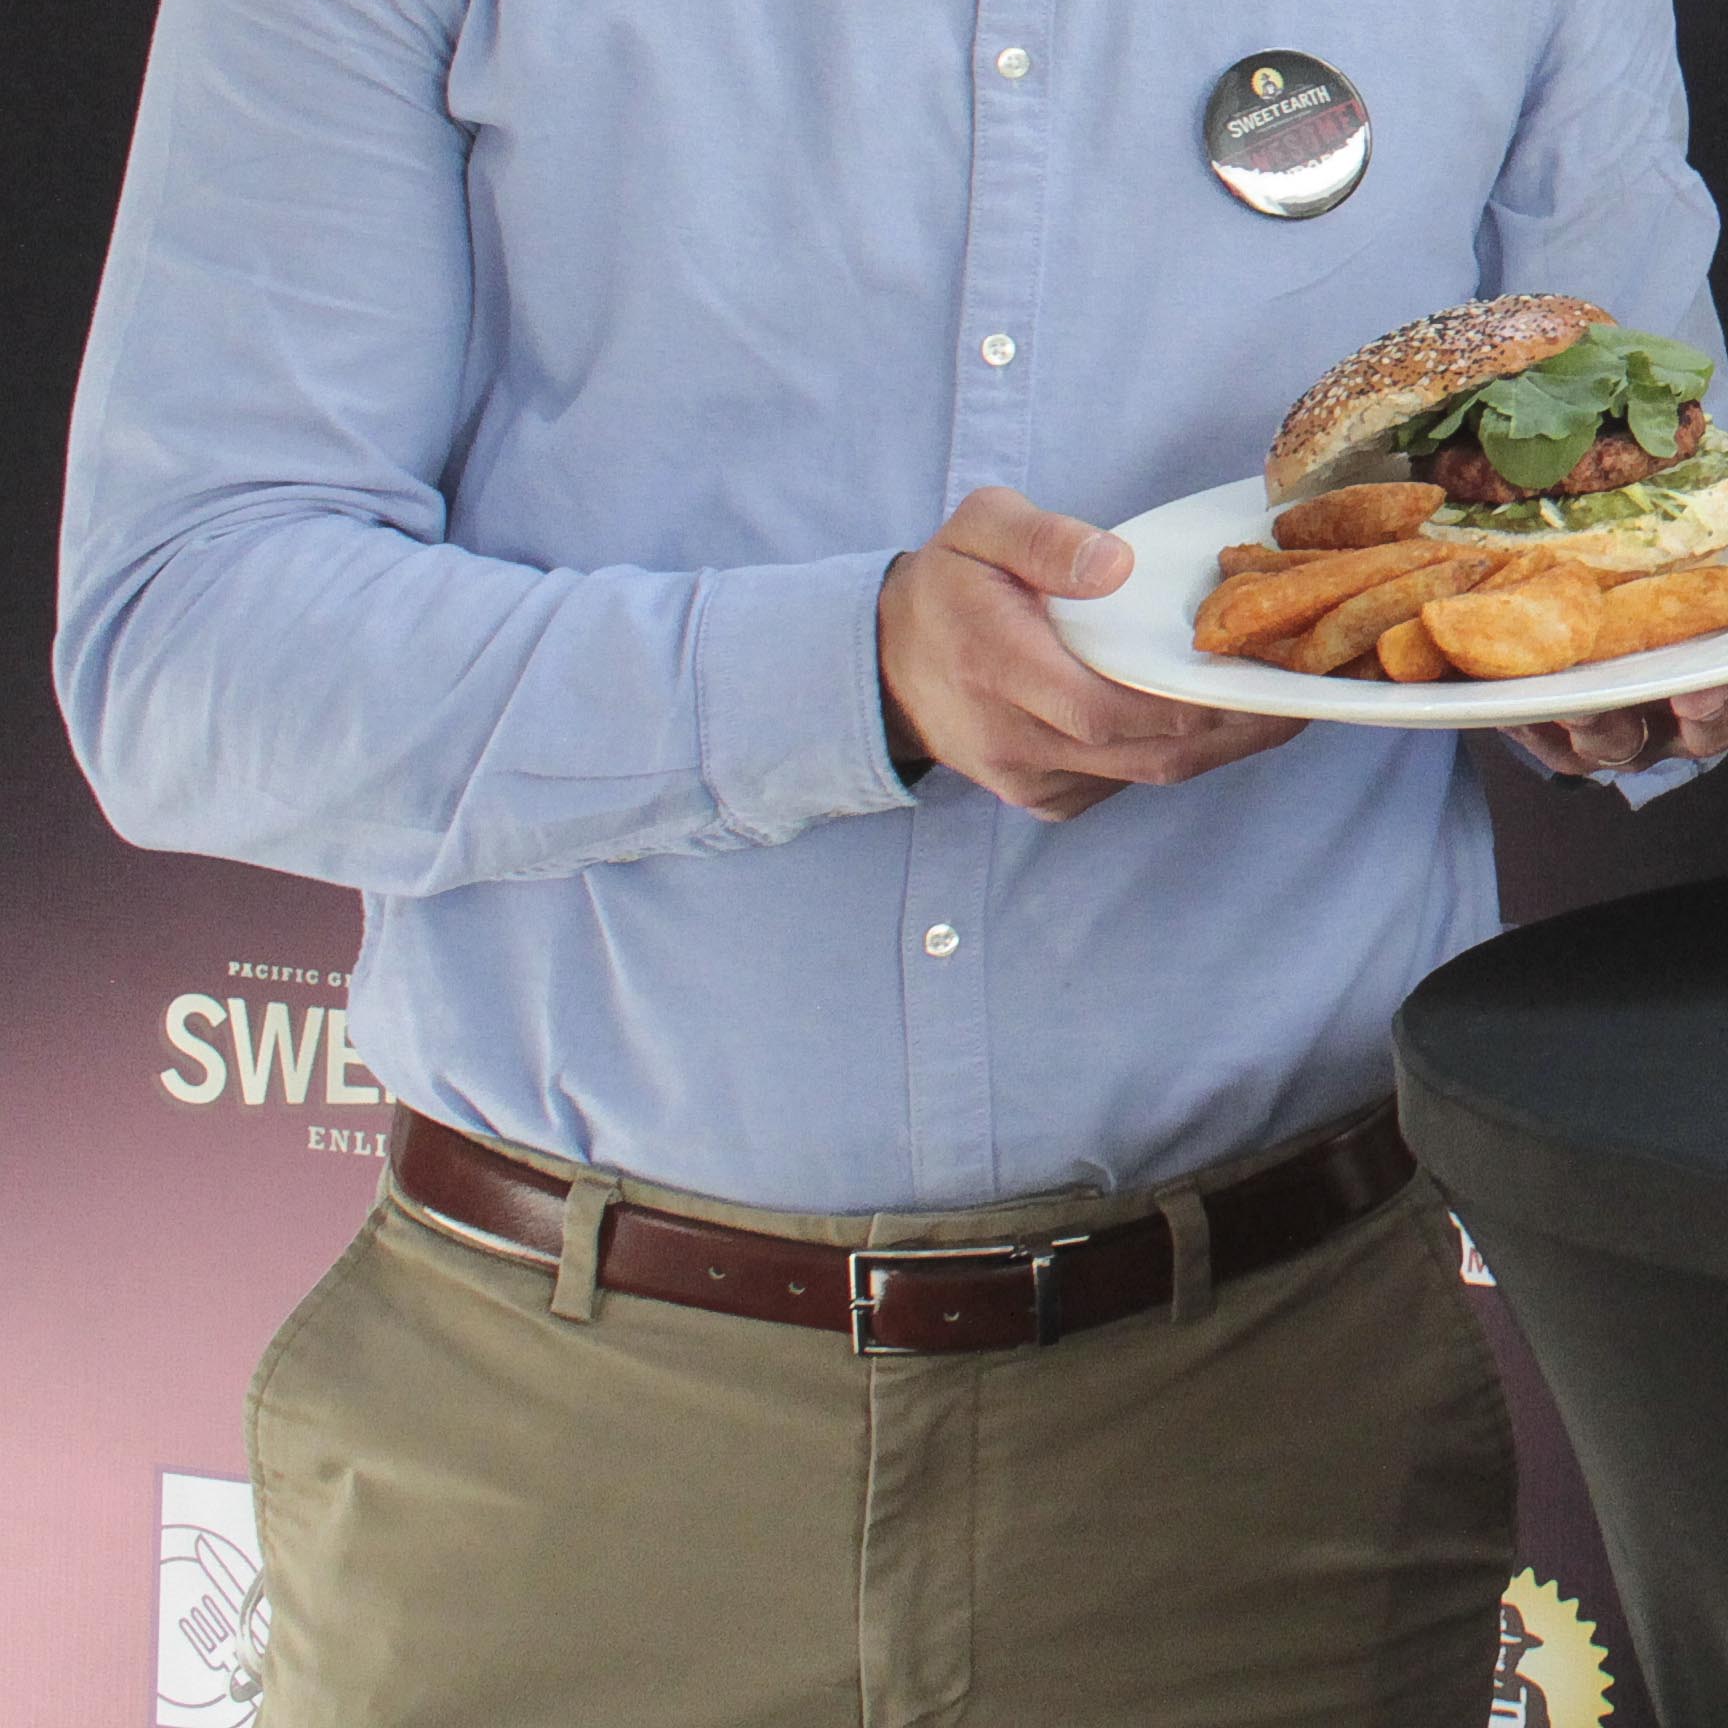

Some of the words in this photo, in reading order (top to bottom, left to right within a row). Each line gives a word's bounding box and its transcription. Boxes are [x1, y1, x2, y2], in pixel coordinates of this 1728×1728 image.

[1227, 104, 1281, 138] SWEET
[1280, 85, 1331, 114] EARTH
[228, 961, 319, 985] PACIFIC
[160, 993, 397, 1105] SWE
